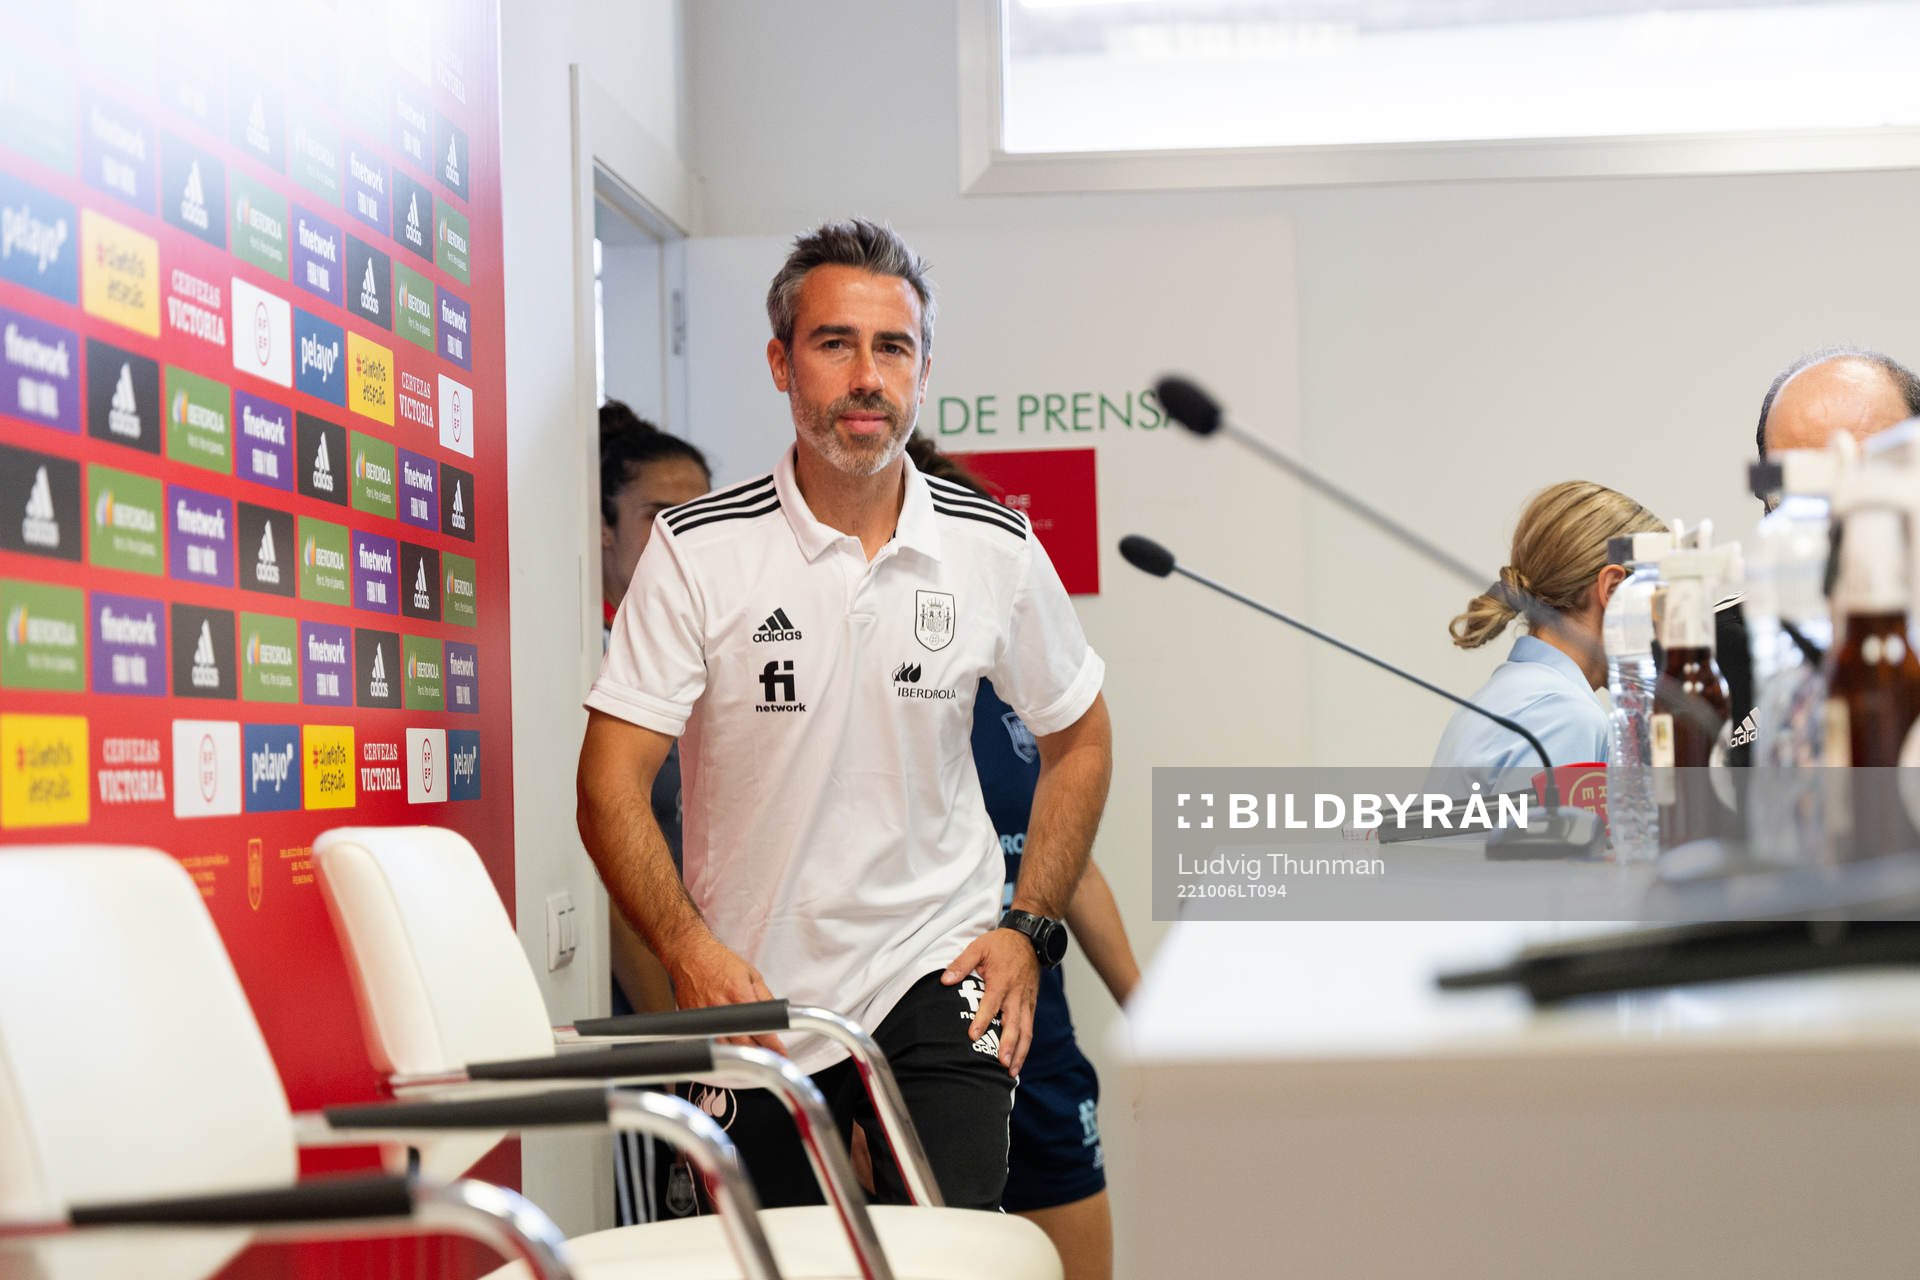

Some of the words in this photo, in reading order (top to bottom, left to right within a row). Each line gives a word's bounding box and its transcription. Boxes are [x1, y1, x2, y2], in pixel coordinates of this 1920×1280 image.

[298, 219, 336, 263] finetwork
[405, 223, 422, 247] adidas
[447, 227, 467, 256] IBERDROLA
[171, 268, 221, 310] CERVEZAS
[361, 290, 379, 315] adidas
[407, 292, 431, 319] IBERDROLA
[167, 295, 226, 347] VICTORIA
[442, 299, 467, 334] finetwork
[301, 333, 333, 383] pelayo
[401, 371, 431, 399] CERVEZAS
[399, 393, 434, 429] VICTORIA
[938, 397, 996, 434] DE
[1018, 389, 1172, 432] PRENS
[243, 405, 285, 446] finetwork
[313, 469, 333, 492] adidas
[366, 461, 391, 485] IBERDROLA
[404, 461, 432, 493] finetwork
[452, 511, 466, 531] adidas
[315, 547, 344, 571] IBERDROLA
[359, 543, 392, 574] finetwork
[256, 561, 280, 584] adidas
[413, 591, 430, 610] adidas
[454, 578, 473, 598] IBERDROLA
[308, 634, 345, 664] finetwork
[752, 630, 802, 643] adidas
[260, 643, 293, 666] IBERDROLA
[450, 652, 474, 678] finetwork
[416, 661, 440, 679] IBERDROLA
[759, 660, 796, 702] fi
[370, 679, 389, 698] adidas
[897, 687, 957, 700] IBERDROLA
[755, 702, 806, 713] network
[102, 738, 160, 764] CERVEZAS
[363, 743, 398, 761] CERVEZAS
[252, 743, 288, 793] pelayo
[453, 746, 473, 784] pelayo
[97, 769, 166, 804] VICTORIA
[361, 767, 402, 791] VICTORIA
